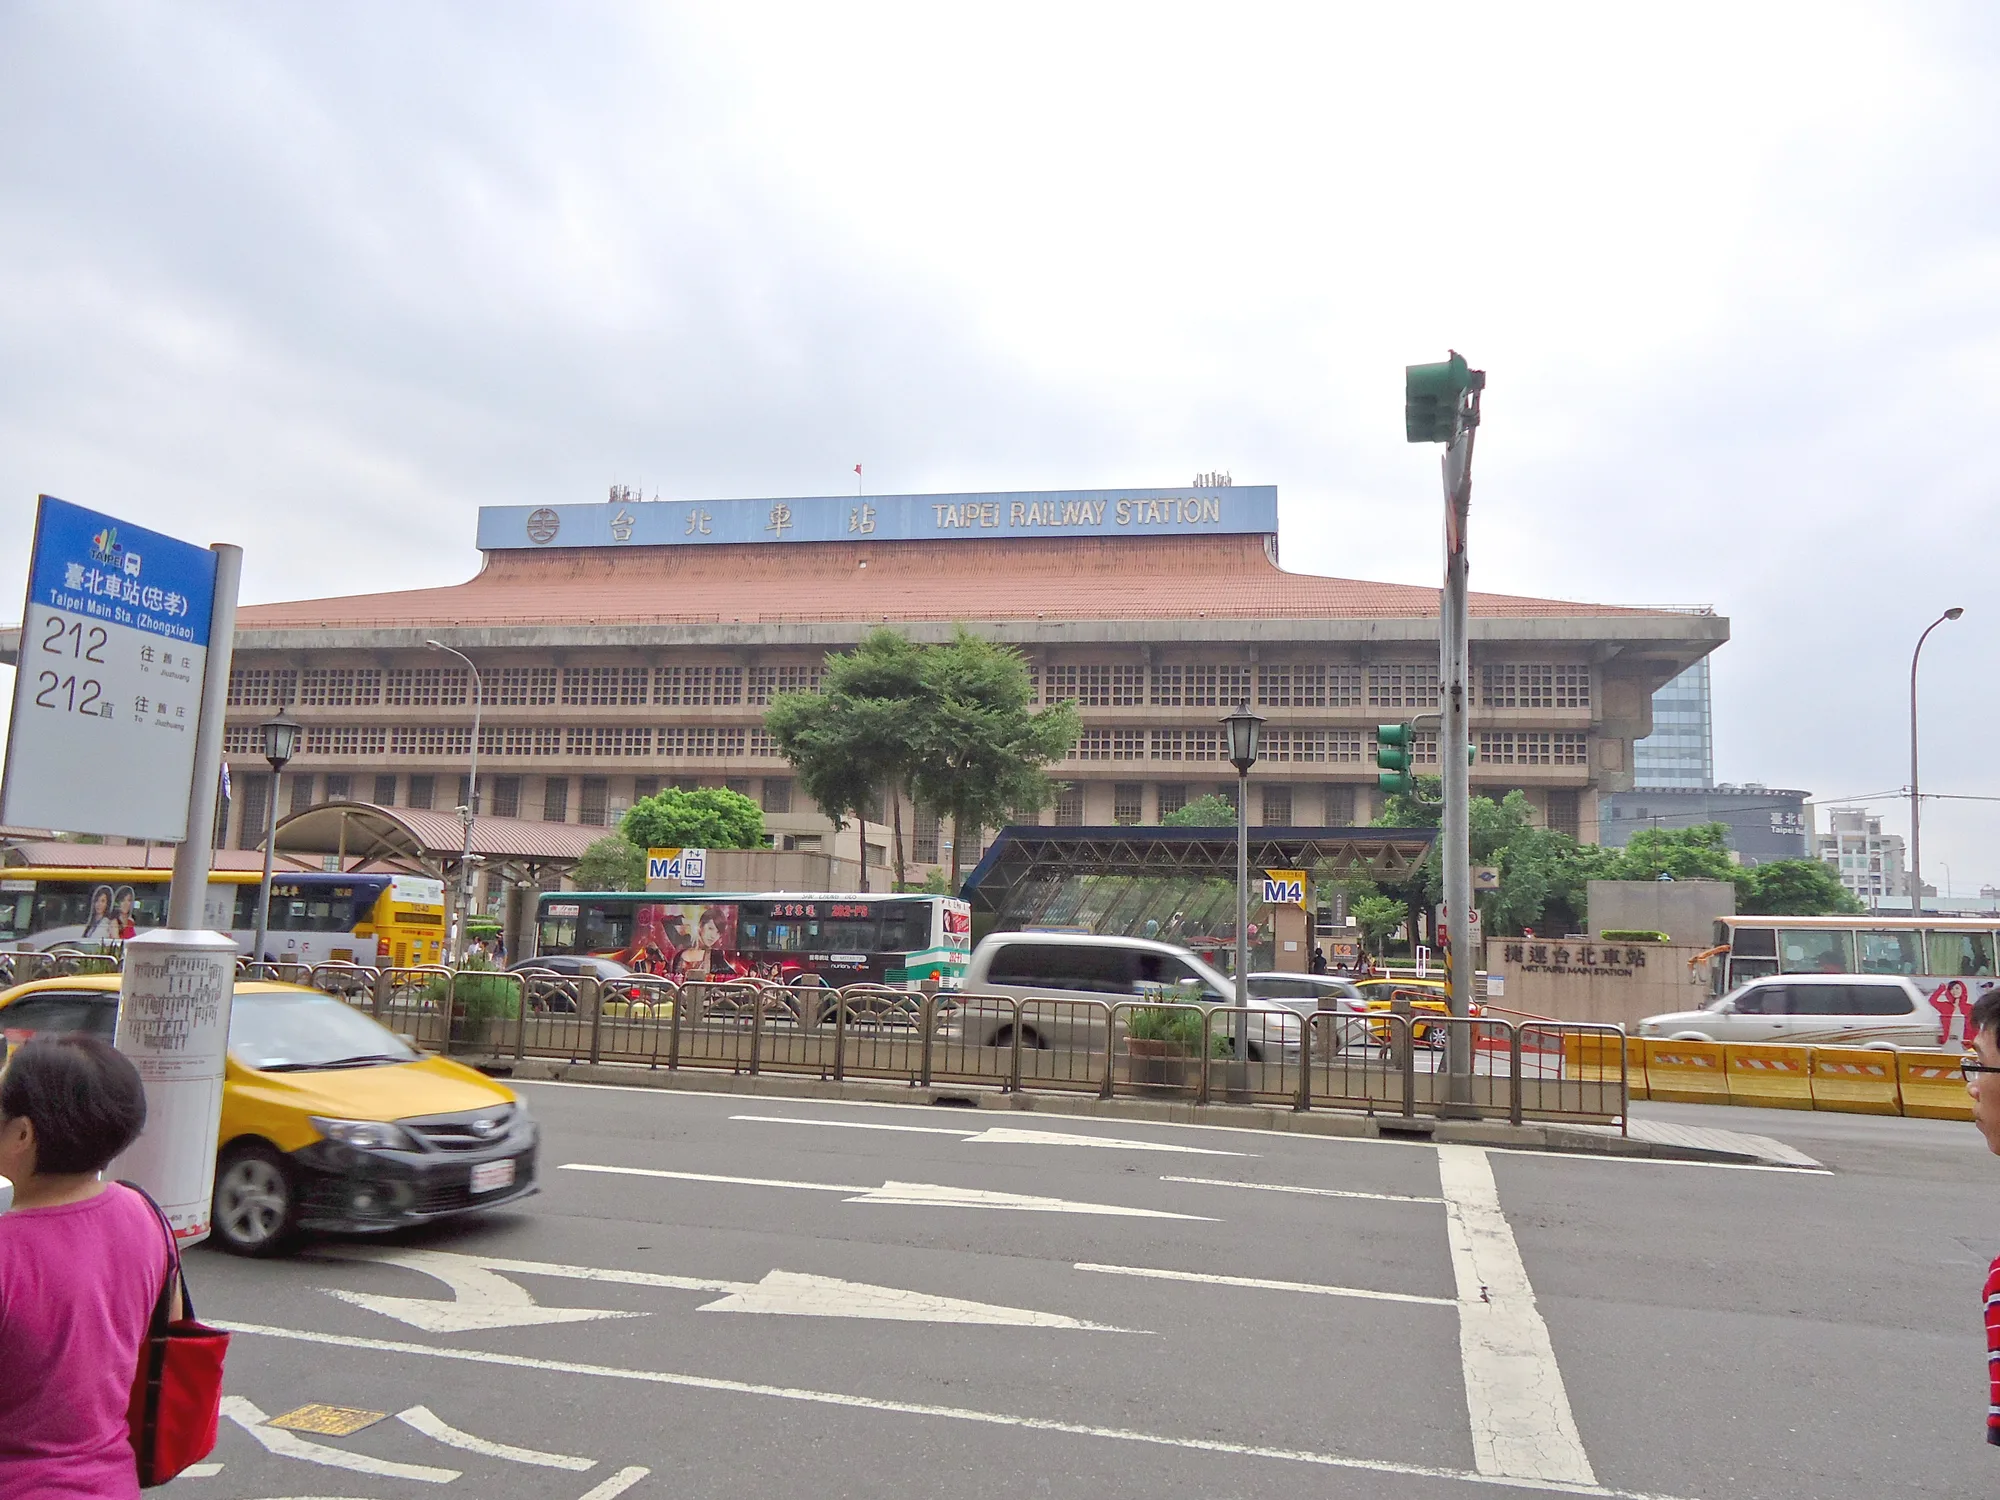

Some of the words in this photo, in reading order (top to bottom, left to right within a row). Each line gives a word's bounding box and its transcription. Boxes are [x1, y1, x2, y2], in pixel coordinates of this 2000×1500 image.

[609, 503, 877, 541] 台北車站
[932, 502, 1000, 529] TAIPEI
[1009, 499, 1108, 527] RAILWAY
[1115, 496, 1219, 525] STATION
[90, 549, 124, 568] TAIPEI
[50, 589, 84, 608] Taipei
[87, 599, 112, 618] Main
[115, 606, 134, 625] Sta.
[137, 612, 194, 641] (Zhongxiao)
[42, 616, 108, 664] 212
[140, 644, 155, 663] 往
[140, 664, 149, 672] To
[160, 669, 190, 683] Jiuzhuang
[135, 695, 149, 714] 往
[134, 714, 143, 723] To
[154, 719, 185, 732] Jiuzhuang
[1770, 826, 1794, 835] Taipei
[650, 859, 681, 877] M4
[1264, 881, 1302, 902] M4
[1334, 944, 1352, 955] K2
[1504, 944, 1646, 968] 捷運台北車站
[1521, 965, 1540, 973] MRT
[1542, 965, 1567, 974] TAIPEI
[1567, 966, 1592, 975] MAIN
[1594, 967, 1633, 977] STATION
